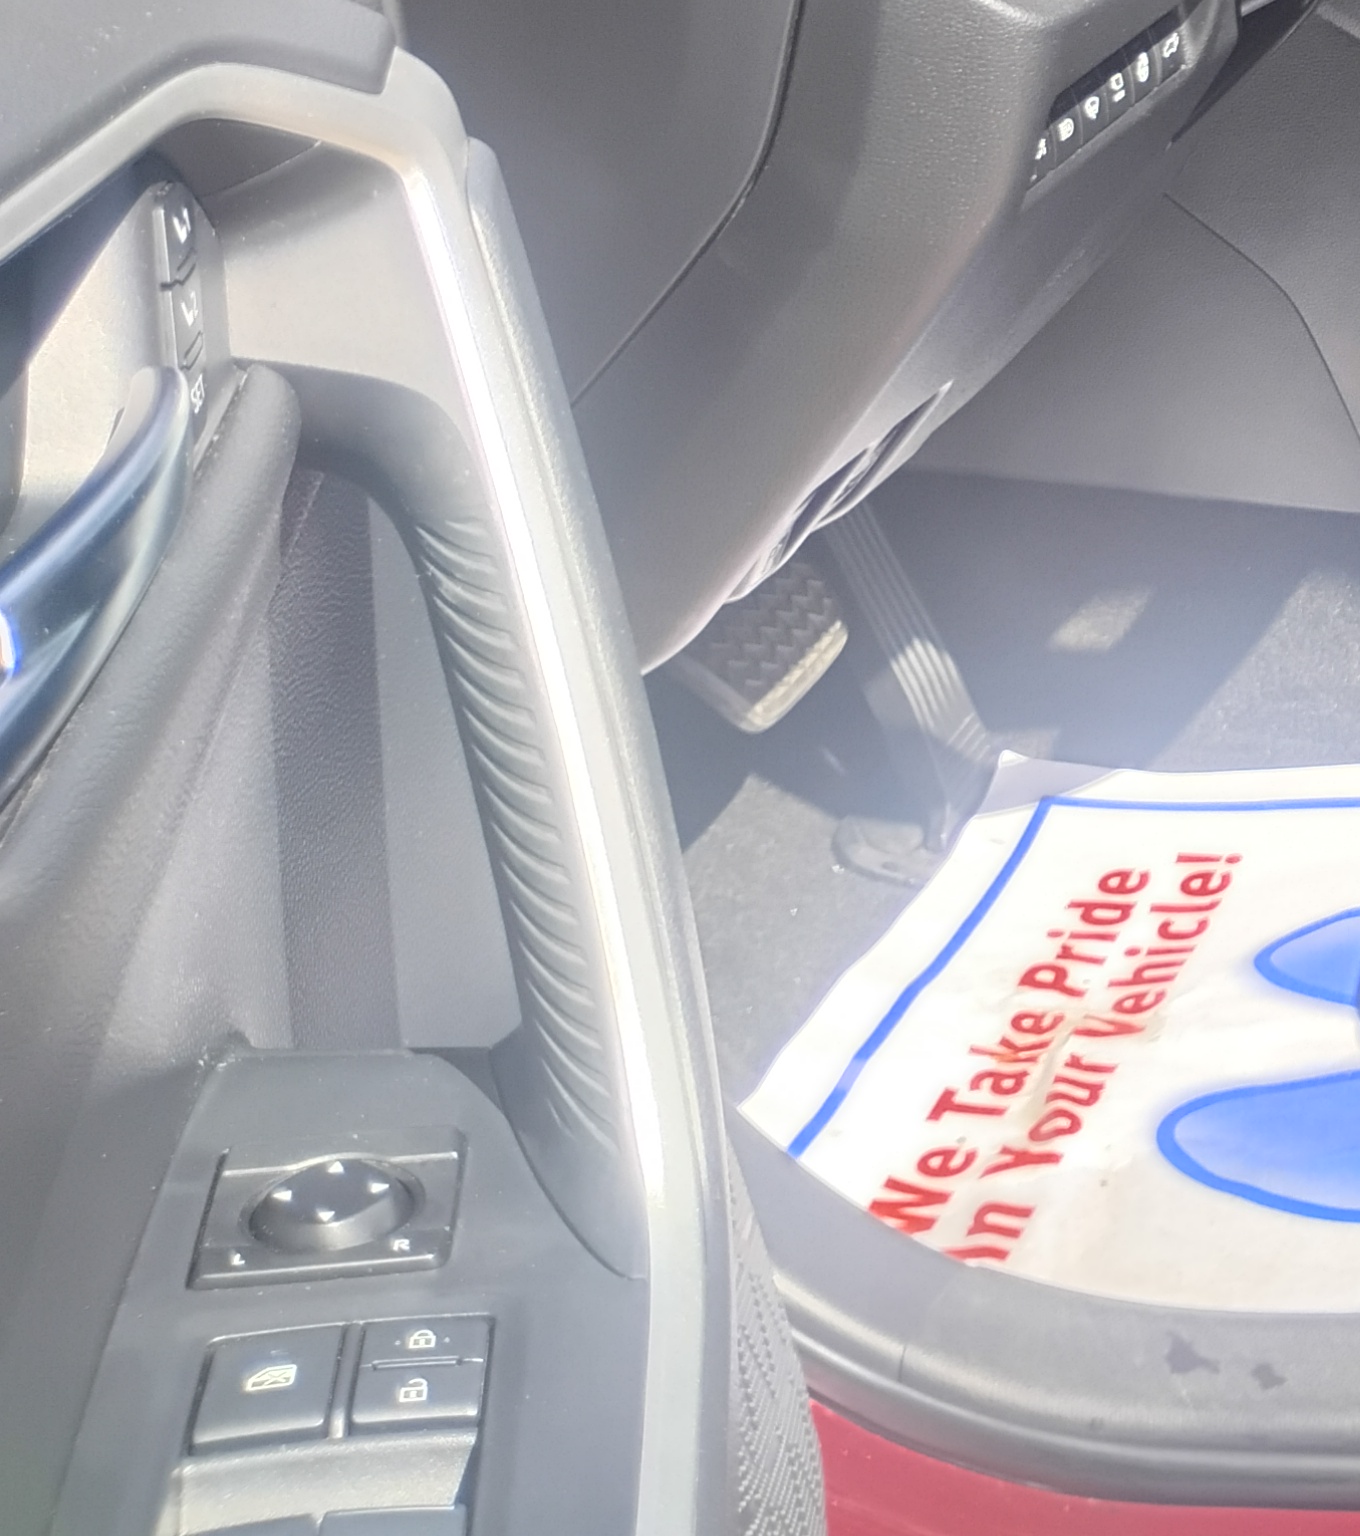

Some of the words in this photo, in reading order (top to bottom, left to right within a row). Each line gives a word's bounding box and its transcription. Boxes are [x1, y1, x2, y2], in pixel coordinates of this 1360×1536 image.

[1074, 851, 1243, 1039] Vehicle!
[868, 1145, 978, 1236] We
[926, 1010, 1066, 1122] Take
[1017, 867, 1152, 999] Pride
[979, 1052, 1120, 1179] Your
[231, 1252, 246, 1266] L
[393, 1238, 411, 1252] R
[943, 1201, 1036, 1262] In
